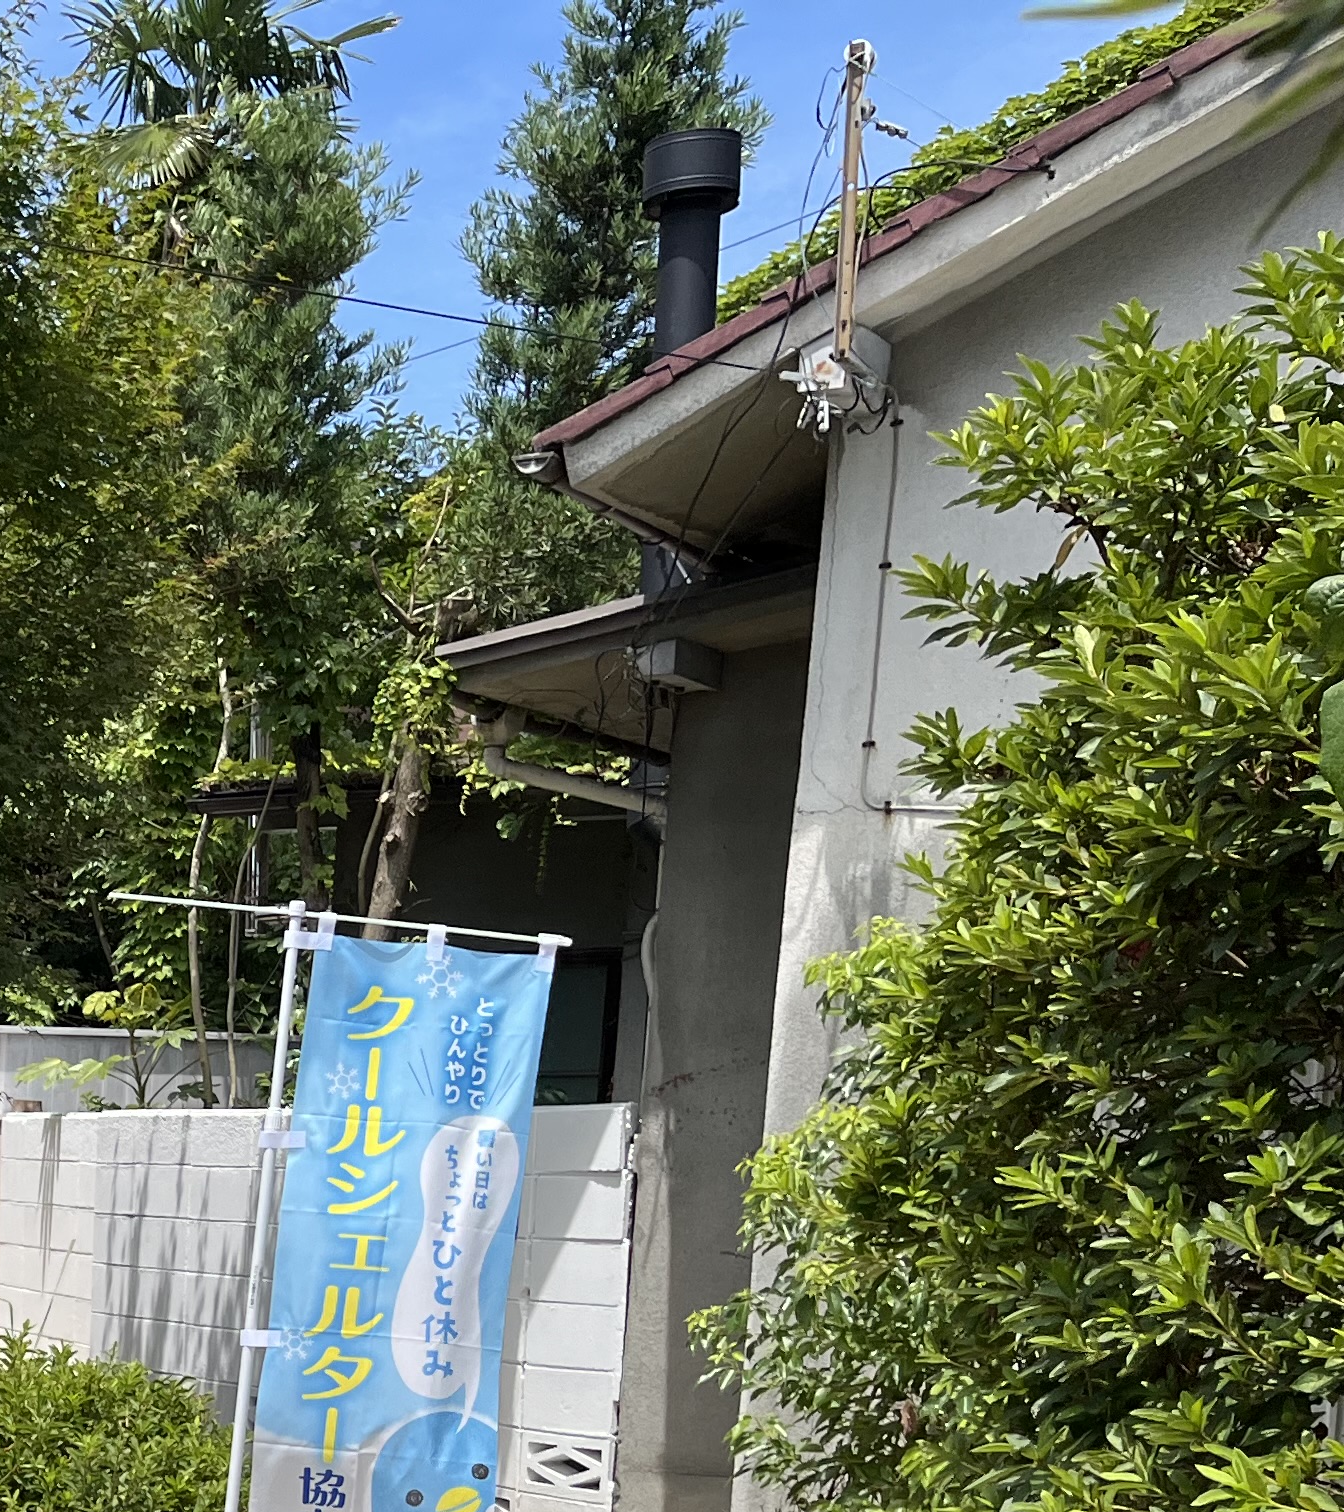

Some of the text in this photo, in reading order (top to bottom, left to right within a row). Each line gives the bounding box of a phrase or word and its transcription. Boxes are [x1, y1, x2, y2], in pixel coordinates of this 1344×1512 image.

[443, 1014, 470, 1106] ひんやり
[466, 996, 497, 1111] とっとりで
[301, 985, 415, 1464] クールシェルター
[420, 1143, 463, 1380] ちょっとひと休み
